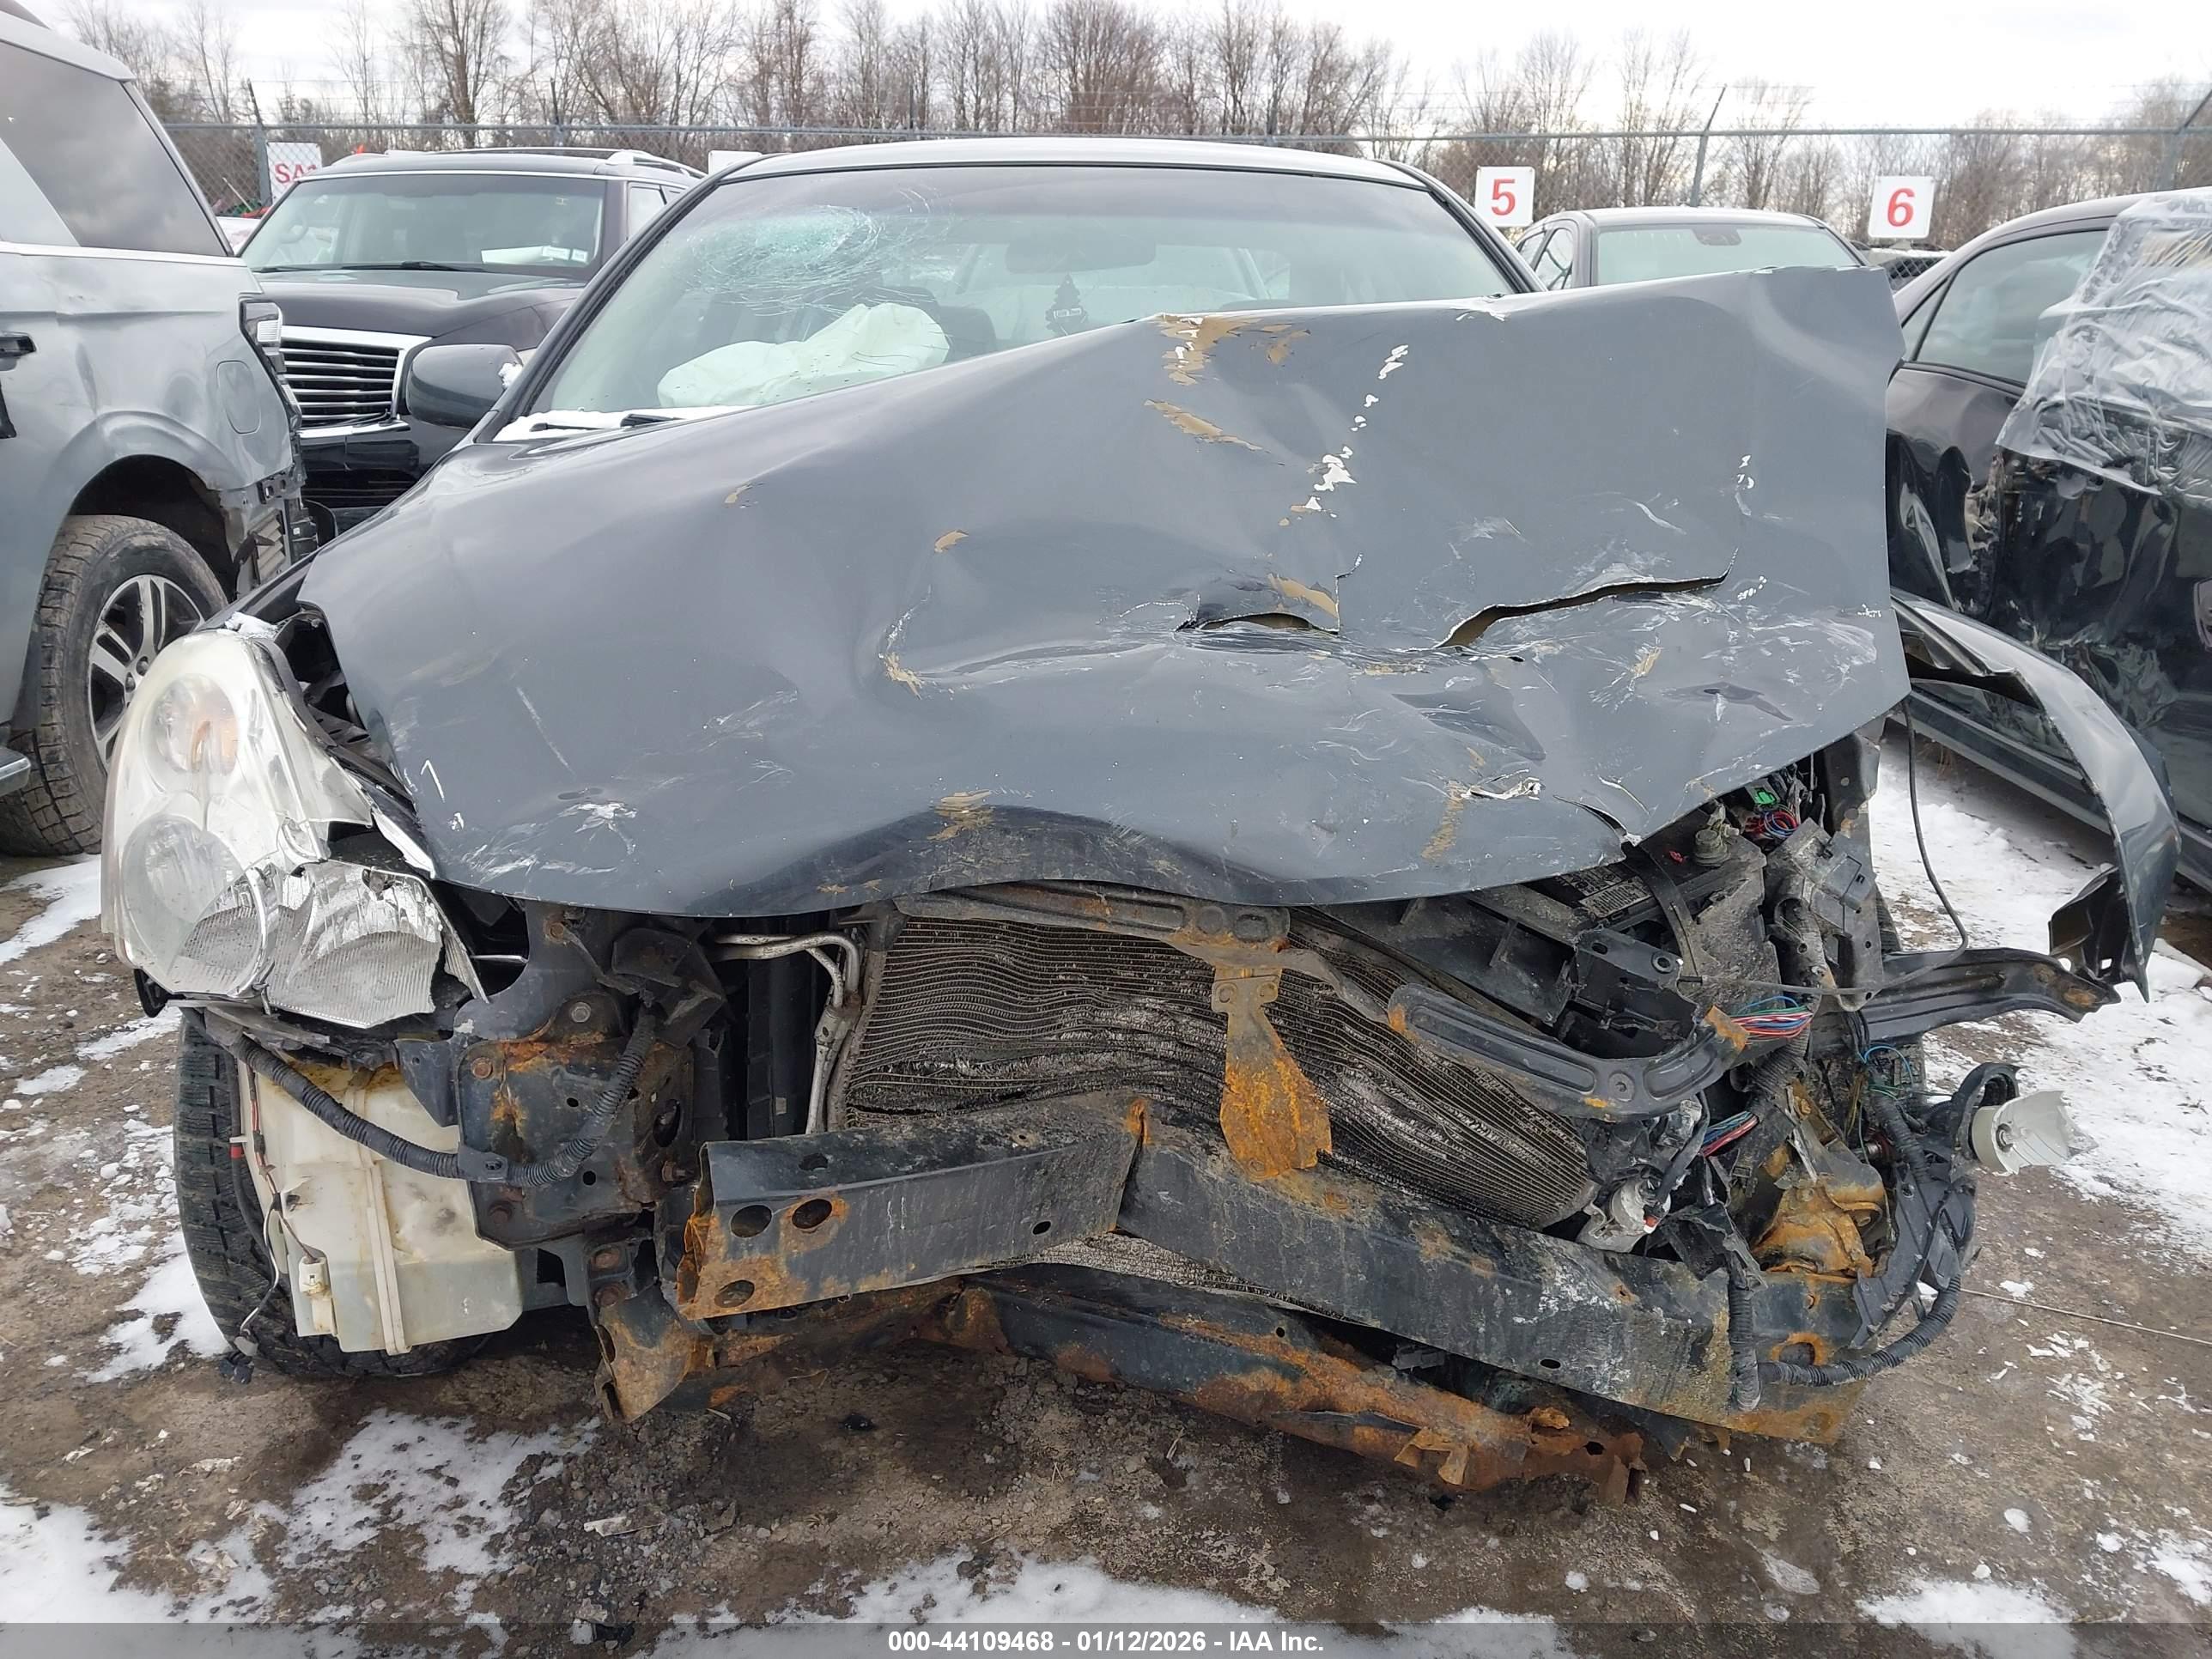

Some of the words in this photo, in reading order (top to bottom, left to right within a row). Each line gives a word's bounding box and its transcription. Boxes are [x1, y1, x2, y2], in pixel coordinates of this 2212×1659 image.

[274, 163, 317, 184] SA
[1492, 178, 1516, 216] 5
[1887, 187, 1915, 227] 6
